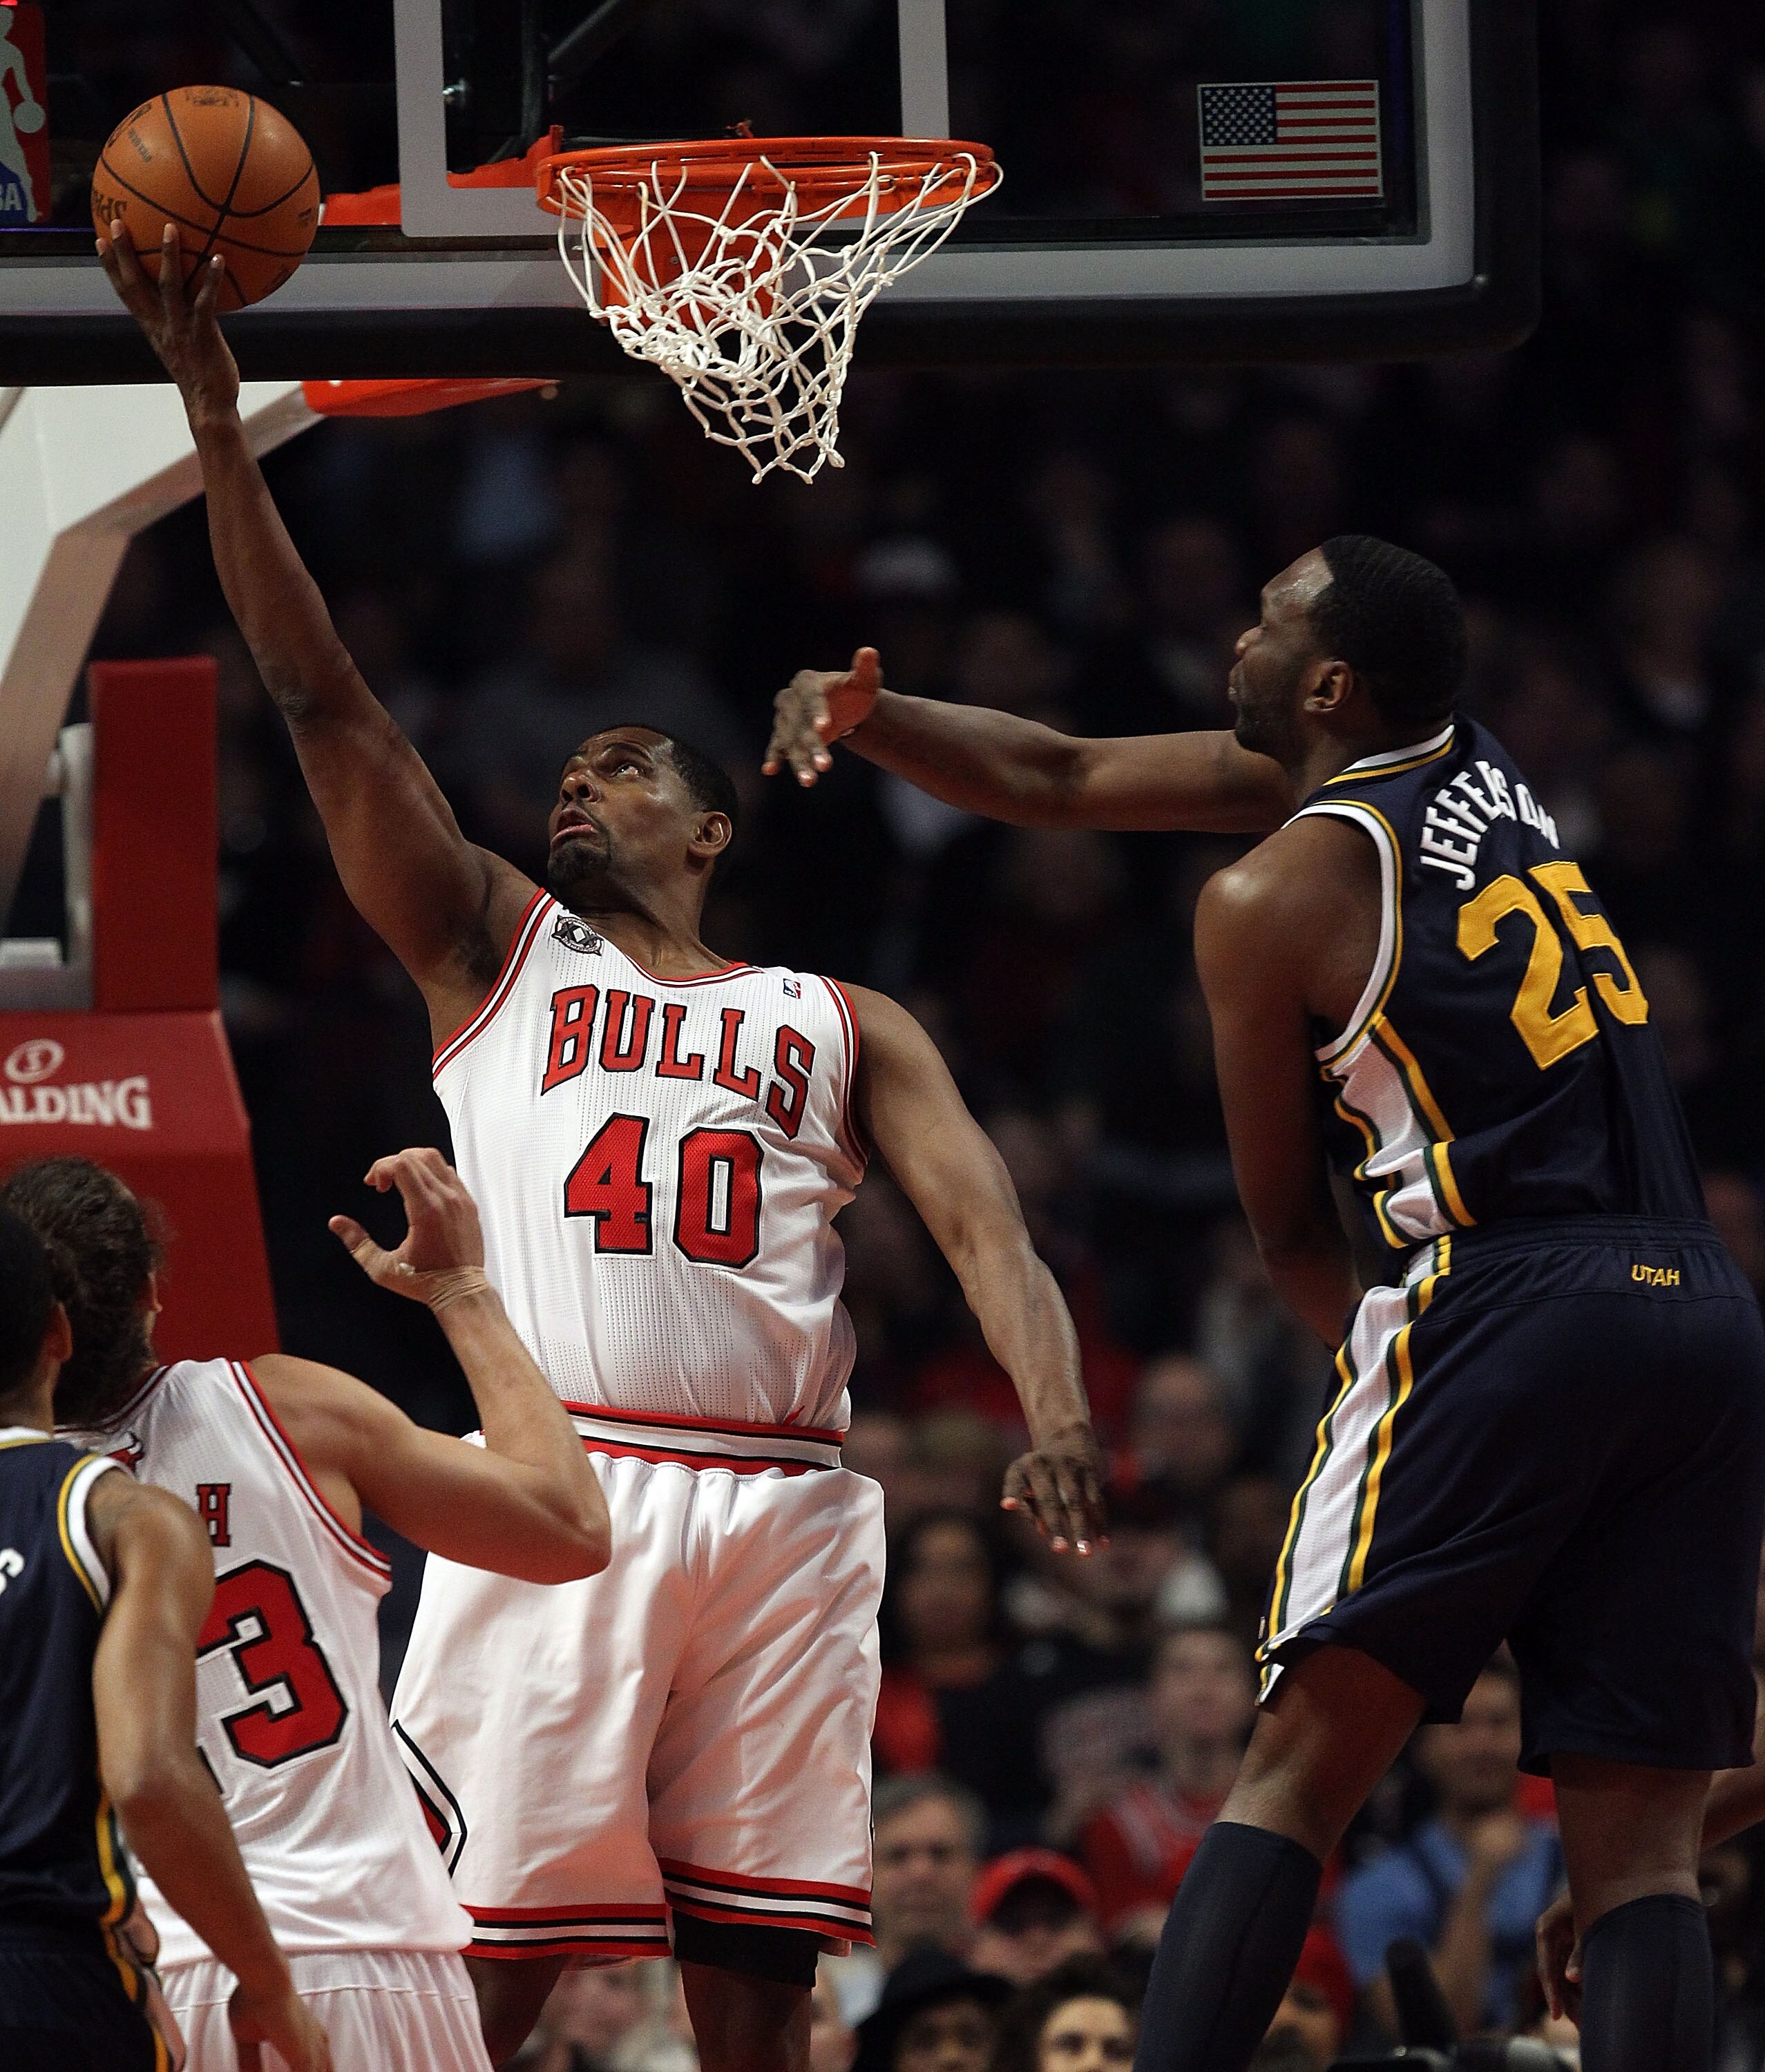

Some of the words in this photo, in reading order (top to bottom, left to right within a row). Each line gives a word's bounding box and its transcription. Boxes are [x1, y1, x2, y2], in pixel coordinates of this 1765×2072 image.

[1456, 861, 1649, 1071] 25
[541, 984, 816, 1140] BULLS
[563, 1112, 764, 1269] 40
[1631, 1264, 1680, 1287] UTAH
